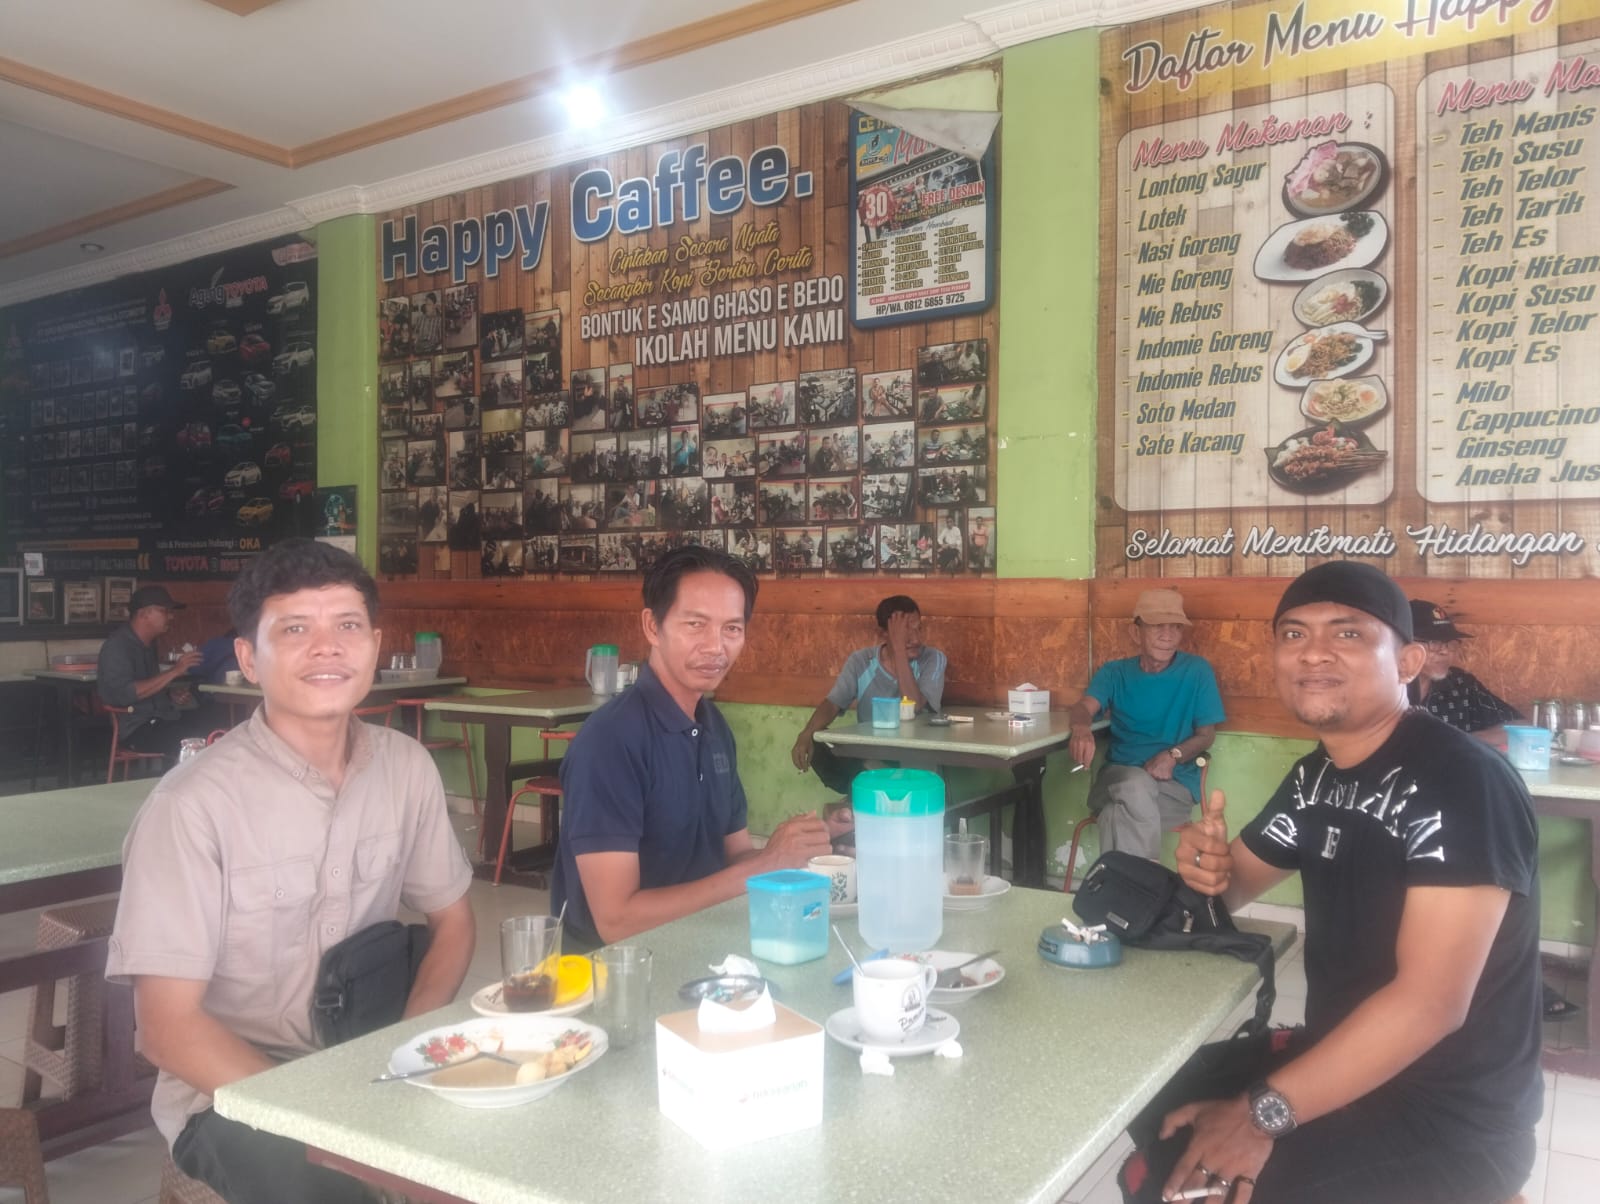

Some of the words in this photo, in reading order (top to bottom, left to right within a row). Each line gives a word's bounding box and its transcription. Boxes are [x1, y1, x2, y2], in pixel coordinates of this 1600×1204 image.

[1124, 26, 1253, 92] Daftar
[1263, 4, 1382, 69] Menu
[1436, 79, 1535, 116] Menu
[1132, 137, 1209, 169] Menu
[1216, 111, 1351, 157] Makanan
[1459, 119, 1503, 147] Teh
[1511, 104, 1597, 138] Manis
[1459, 147, 1503, 174] Teh
[1512, 137, 1584, 165] Susu
[921, 190, 947, 205] FREE
[949, 181, 985, 201] DESAIN
[1138, 172, 1207, 201] Lontong
[1212, 160, 1267, 191] Sayur
[1459, 174, 1503, 201] Teh
[1515, 165, 1586, 193] Telor
[381, 198, 551, 283] Happy
[570, 144, 814, 243] Caffee.
[866, 192, 888, 220] 30
[1138, 208, 1187, 234] Lotek
[1459, 201, 1503, 229] Teh
[1515, 191, 1587, 221] Tarik
[609, 247, 669, 275] Ciptakan
[675, 235, 729, 262] Secara
[735, 221, 782, 252] Nyata
[1138, 243, 1173, 266] Nasi
[1178, 231, 1242, 260] Goreng
[1459, 228, 1503, 256] Teh
[1511, 226, 1548, 249] Es
[583, 279, 655, 306] Secangkir
[660, 266, 695, 295] Kopi
[700, 257, 757, 288] Beribu
[763, 246, 815, 276] Cerita
[1137, 275, 1167, 297] Mie
[1171, 264, 1233, 293] Goreng
[1455, 259, 1519, 290] Kopi
[581, 307, 643, 339] BONTUK
[647, 304, 658, 329] E
[661, 297, 709, 328] SAMO
[713, 286, 772, 320] GHASO
[777, 283, 788, 311] E
[793, 274, 844, 307] BEDO
[903, 299, 922, 310] 0812
[925, 296, 943, 307] 6855
[945, 293, 965, 305] 9725
[1137, 307, 1165, 329] Mie
[1169, 298, 1224, 324] Rebus
[1455, 287, 1519, 317] Kopi
[1524, 283, 1597, 308] Susu
[635, 333, 708, 367] IKOLAH
[714, 317, 777, 356] MENU
[783, 308, 844, 347] KAMI
[1455, 315, 1519, 345] Kopi
[1528, 310, 1599, 336] Telor
[1137, 337, 1203, 362] Indomie
[1208, 327, 1275, 356] Goreng
[1455, 343, 1519, 371] Kopi
[1524, 340, 1561, 365] Es
[1137, 368, 1203, 393] Indomie
[1208, 360, 1264, 385] Rebus
[1455, 381, 1511, 404] Milo
[1137, 402, 1175, 425] Soto
[1179, 399, 1237, 422] Medan
[1456, 403, 1600, 435] Cappucino
[1137, 435, 1176, 458] Sate
[1179, 431, 1246, 456] Kacang
[1455, 436, 1568, 460] Ginseng
[1455, 462, 1541, 486] Aneka
[239, 537, 261, 549] OKA
[1125, 526, 1234, 559] Selamat
[1242, 525, 1397, 558] Menikmati
[1405, 523, 1584, 566] Hidangan
[164, 557, 209, 572] TOYOTA
